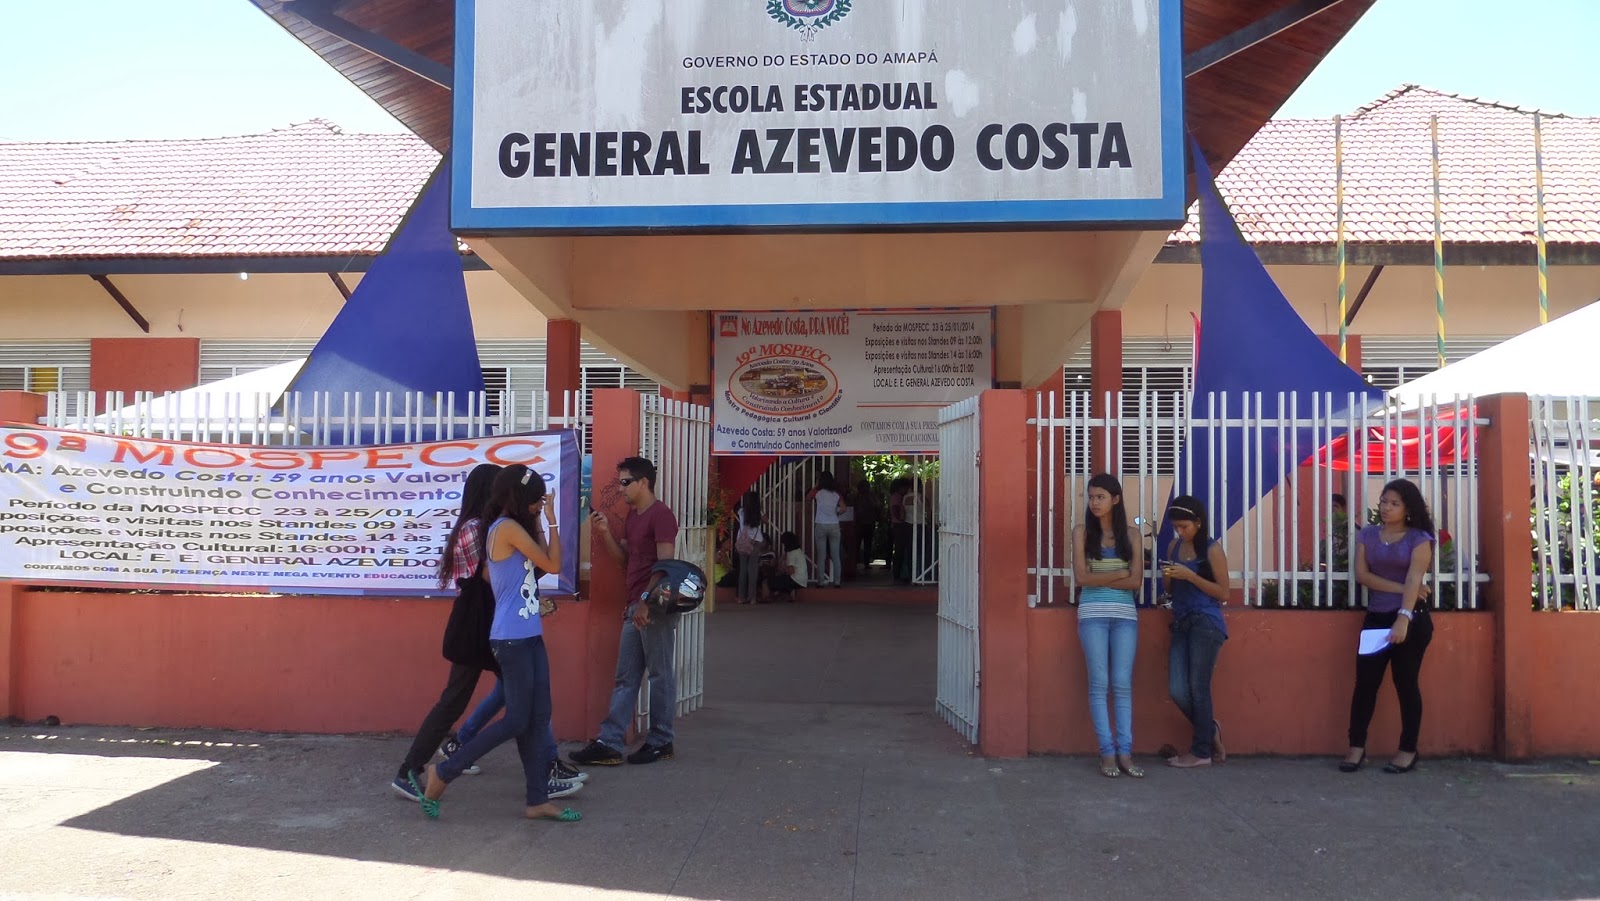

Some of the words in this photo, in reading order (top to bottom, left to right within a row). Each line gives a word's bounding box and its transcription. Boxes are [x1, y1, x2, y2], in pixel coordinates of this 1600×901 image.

[683, 56, 758, 69] GOVERNO
[763, 55, 785, 67] DO
[790, 53, 851, 67] ESTADO
[856, 52, 878, 65] DO
[883, 49, 938, 65] AMAPÁ
[682, 85, 784, 114] ESCOLA
[795, 82, 938, 112] ESTADUAL
[499, 130, 710, 178] GENERAL
[731, 124, 955, 175] AZEVEDO
[976, 121, 1132, 171] COSTA
[741, 316, 752, 336] No
[752, 316, 785, 336] Azevedo
[785, 317, 808, 338] Costa,
[809, 316, 826, 335] PRA
[760, 343, 832, 365] MOSPECC
[905, 378, 930, 388] GENERAL
[930, 377, 955, 387] AZEVEDO
[956, 377, 975, 387] COSTA
[716, 424, 750, 436] Azevedo
[751, 427, 775, 437] Costa:
[777, 428, 786, 437] 59
[787, 429, 806, 437] anos
[807, 424, 853, 437] Valorizando
[110, 438, 547, 470] MOSPECC
[738, 440, 782, 449] Construindo
[784, 440, 840, 449] Conhecimento
[51, 462, 165, 481] Azevedo
[175, 470, 261, 483] Costa:
[270, 472, 302, 483] 59
[309, 474, 376, 484] anos
[59, 484, 77, 493] e
[86, 482, 242, 499] Construindo
[251, 486, 462, 501] Conhecimento
[9, 498, 97, 511] Período
[103, 503, 133, 513] da
[140, 503, 262, 516] MOSPECC
[273, 506, 307, 517] 23
[314, 506, 329, 517] à
[106, 516, 120, 525] e
[126, 516, 203, 526] visitas
[210, 519, 252, 528] nos
[258, 518, 357, 530] Standes
[363, 520, 396, 530] 09
[402, 519, 433, 530] às
[108, 528, 121, 537] e
[126, 528, 203, 538] visitas
[209, 531, 252, 540] nos
[258, 531, 357, 542] Standes
[366, 533, 396, 542] 14
[403, 532, 432, 542] às
[15, 536, 176, 551] Apresentação
[380, 544, 410, 555] às
[59, 550, 142, 562] LOCAL:
[207, 554, 322, 566] GENERAL
[326, 556, 438, 568] AZEVEDO
[24, 563, 90, 572] CONTAMOS
[161, 568, 228, 577] PRESENÇA
